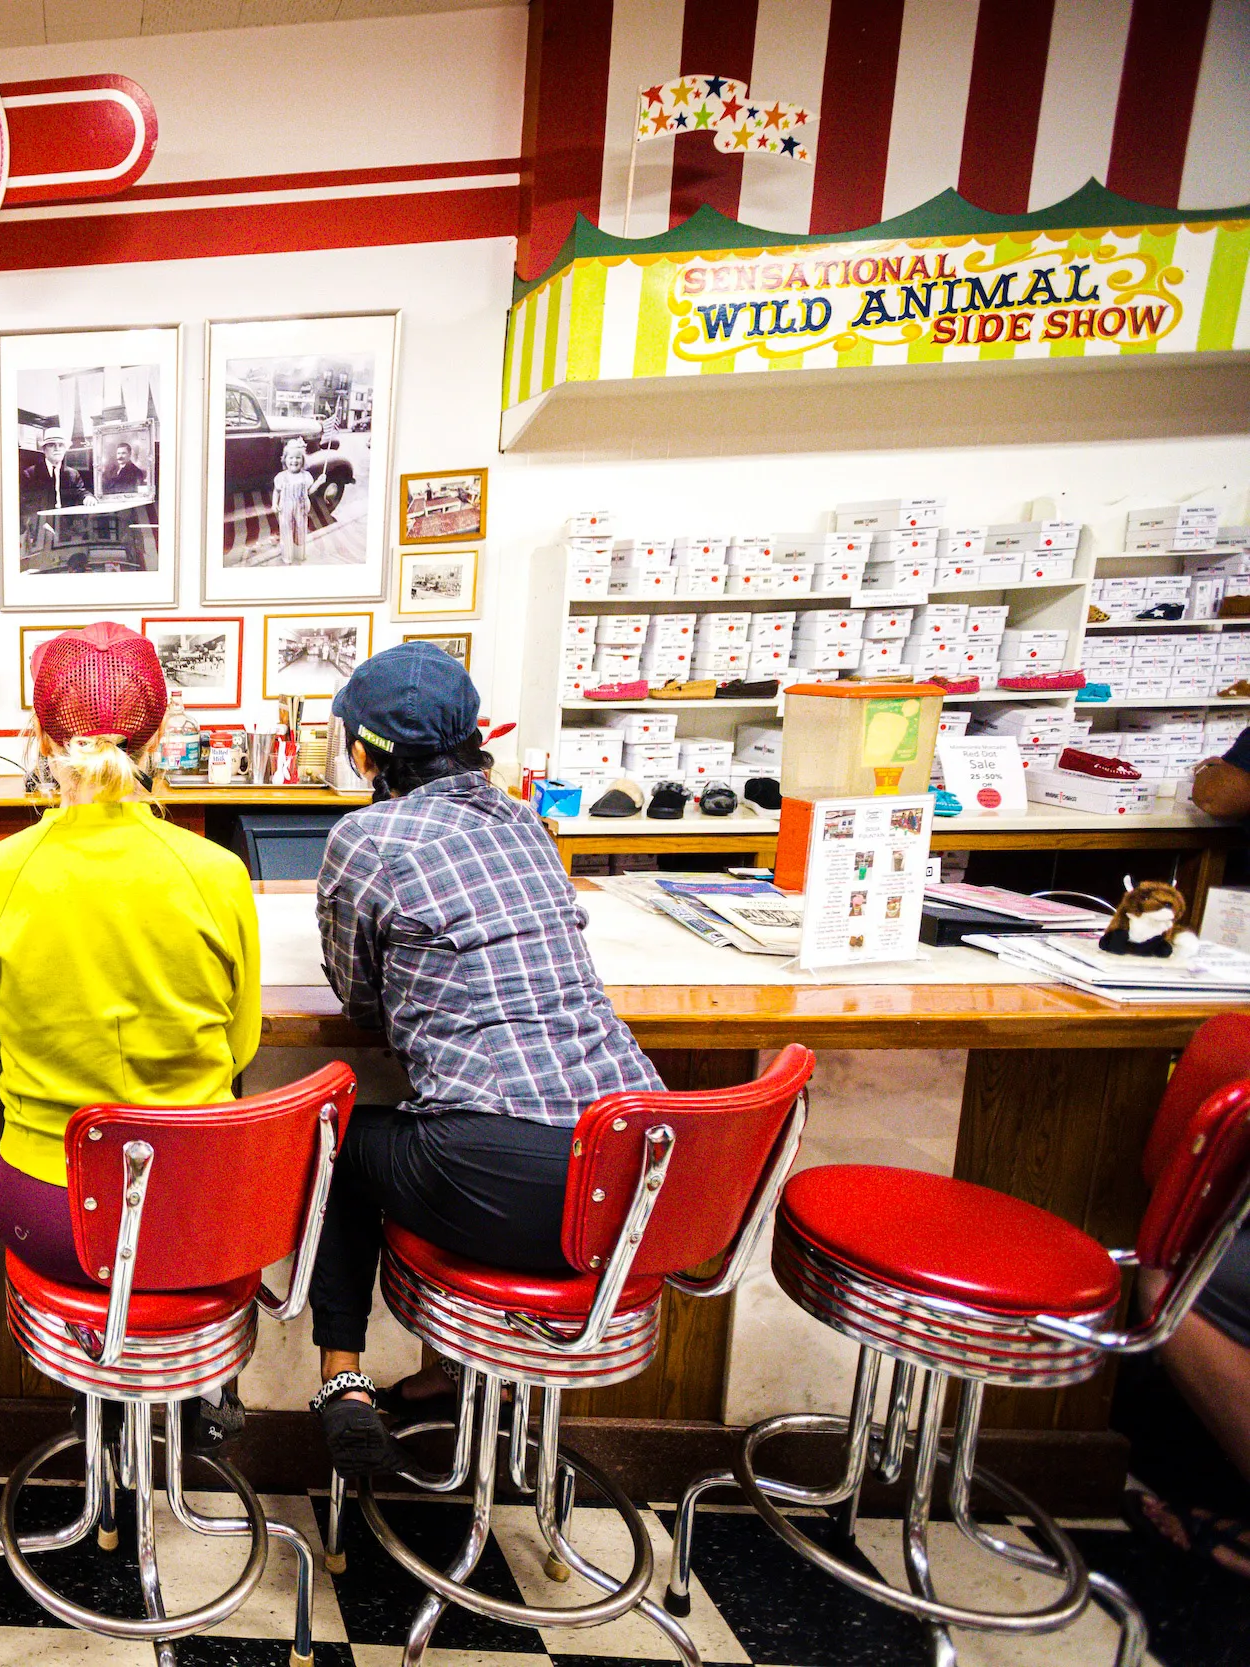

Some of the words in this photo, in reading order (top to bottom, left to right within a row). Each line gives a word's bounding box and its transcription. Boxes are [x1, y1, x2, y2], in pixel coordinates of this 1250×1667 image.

[682, 253, 957, 296] SENSATIONAL
[695, 296, 833, 341] WILD
[852, 264, 1100, 328] ANIMAL
[930, 311, 1036, 345] SIDE
[1042, 303, 1168, 342] SHOW
[969, 759, 996, 769] Sale
